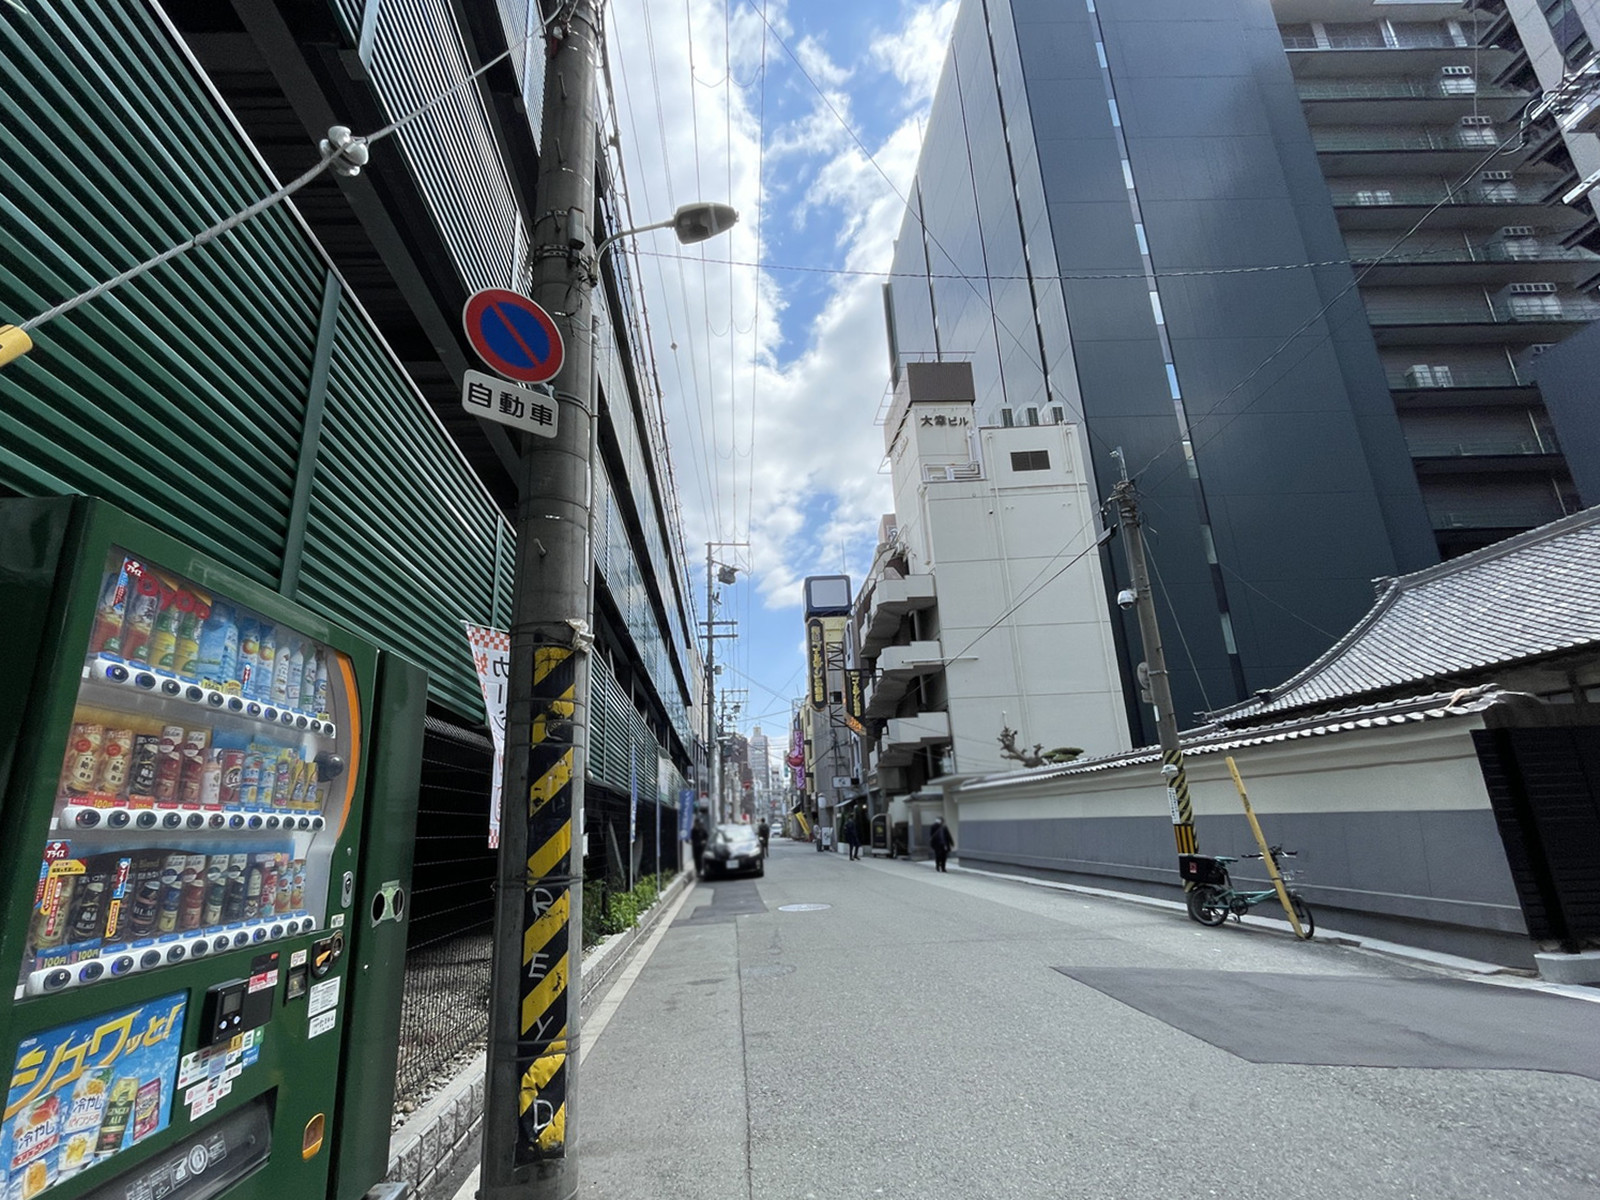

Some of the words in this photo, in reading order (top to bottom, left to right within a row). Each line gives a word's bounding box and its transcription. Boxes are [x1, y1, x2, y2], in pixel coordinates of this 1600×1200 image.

[467, 382, 554, 426] 自動車
[73, 1095, 103, 1114] 冷やし
[18, 1121, 55, 1150] 冷やし
